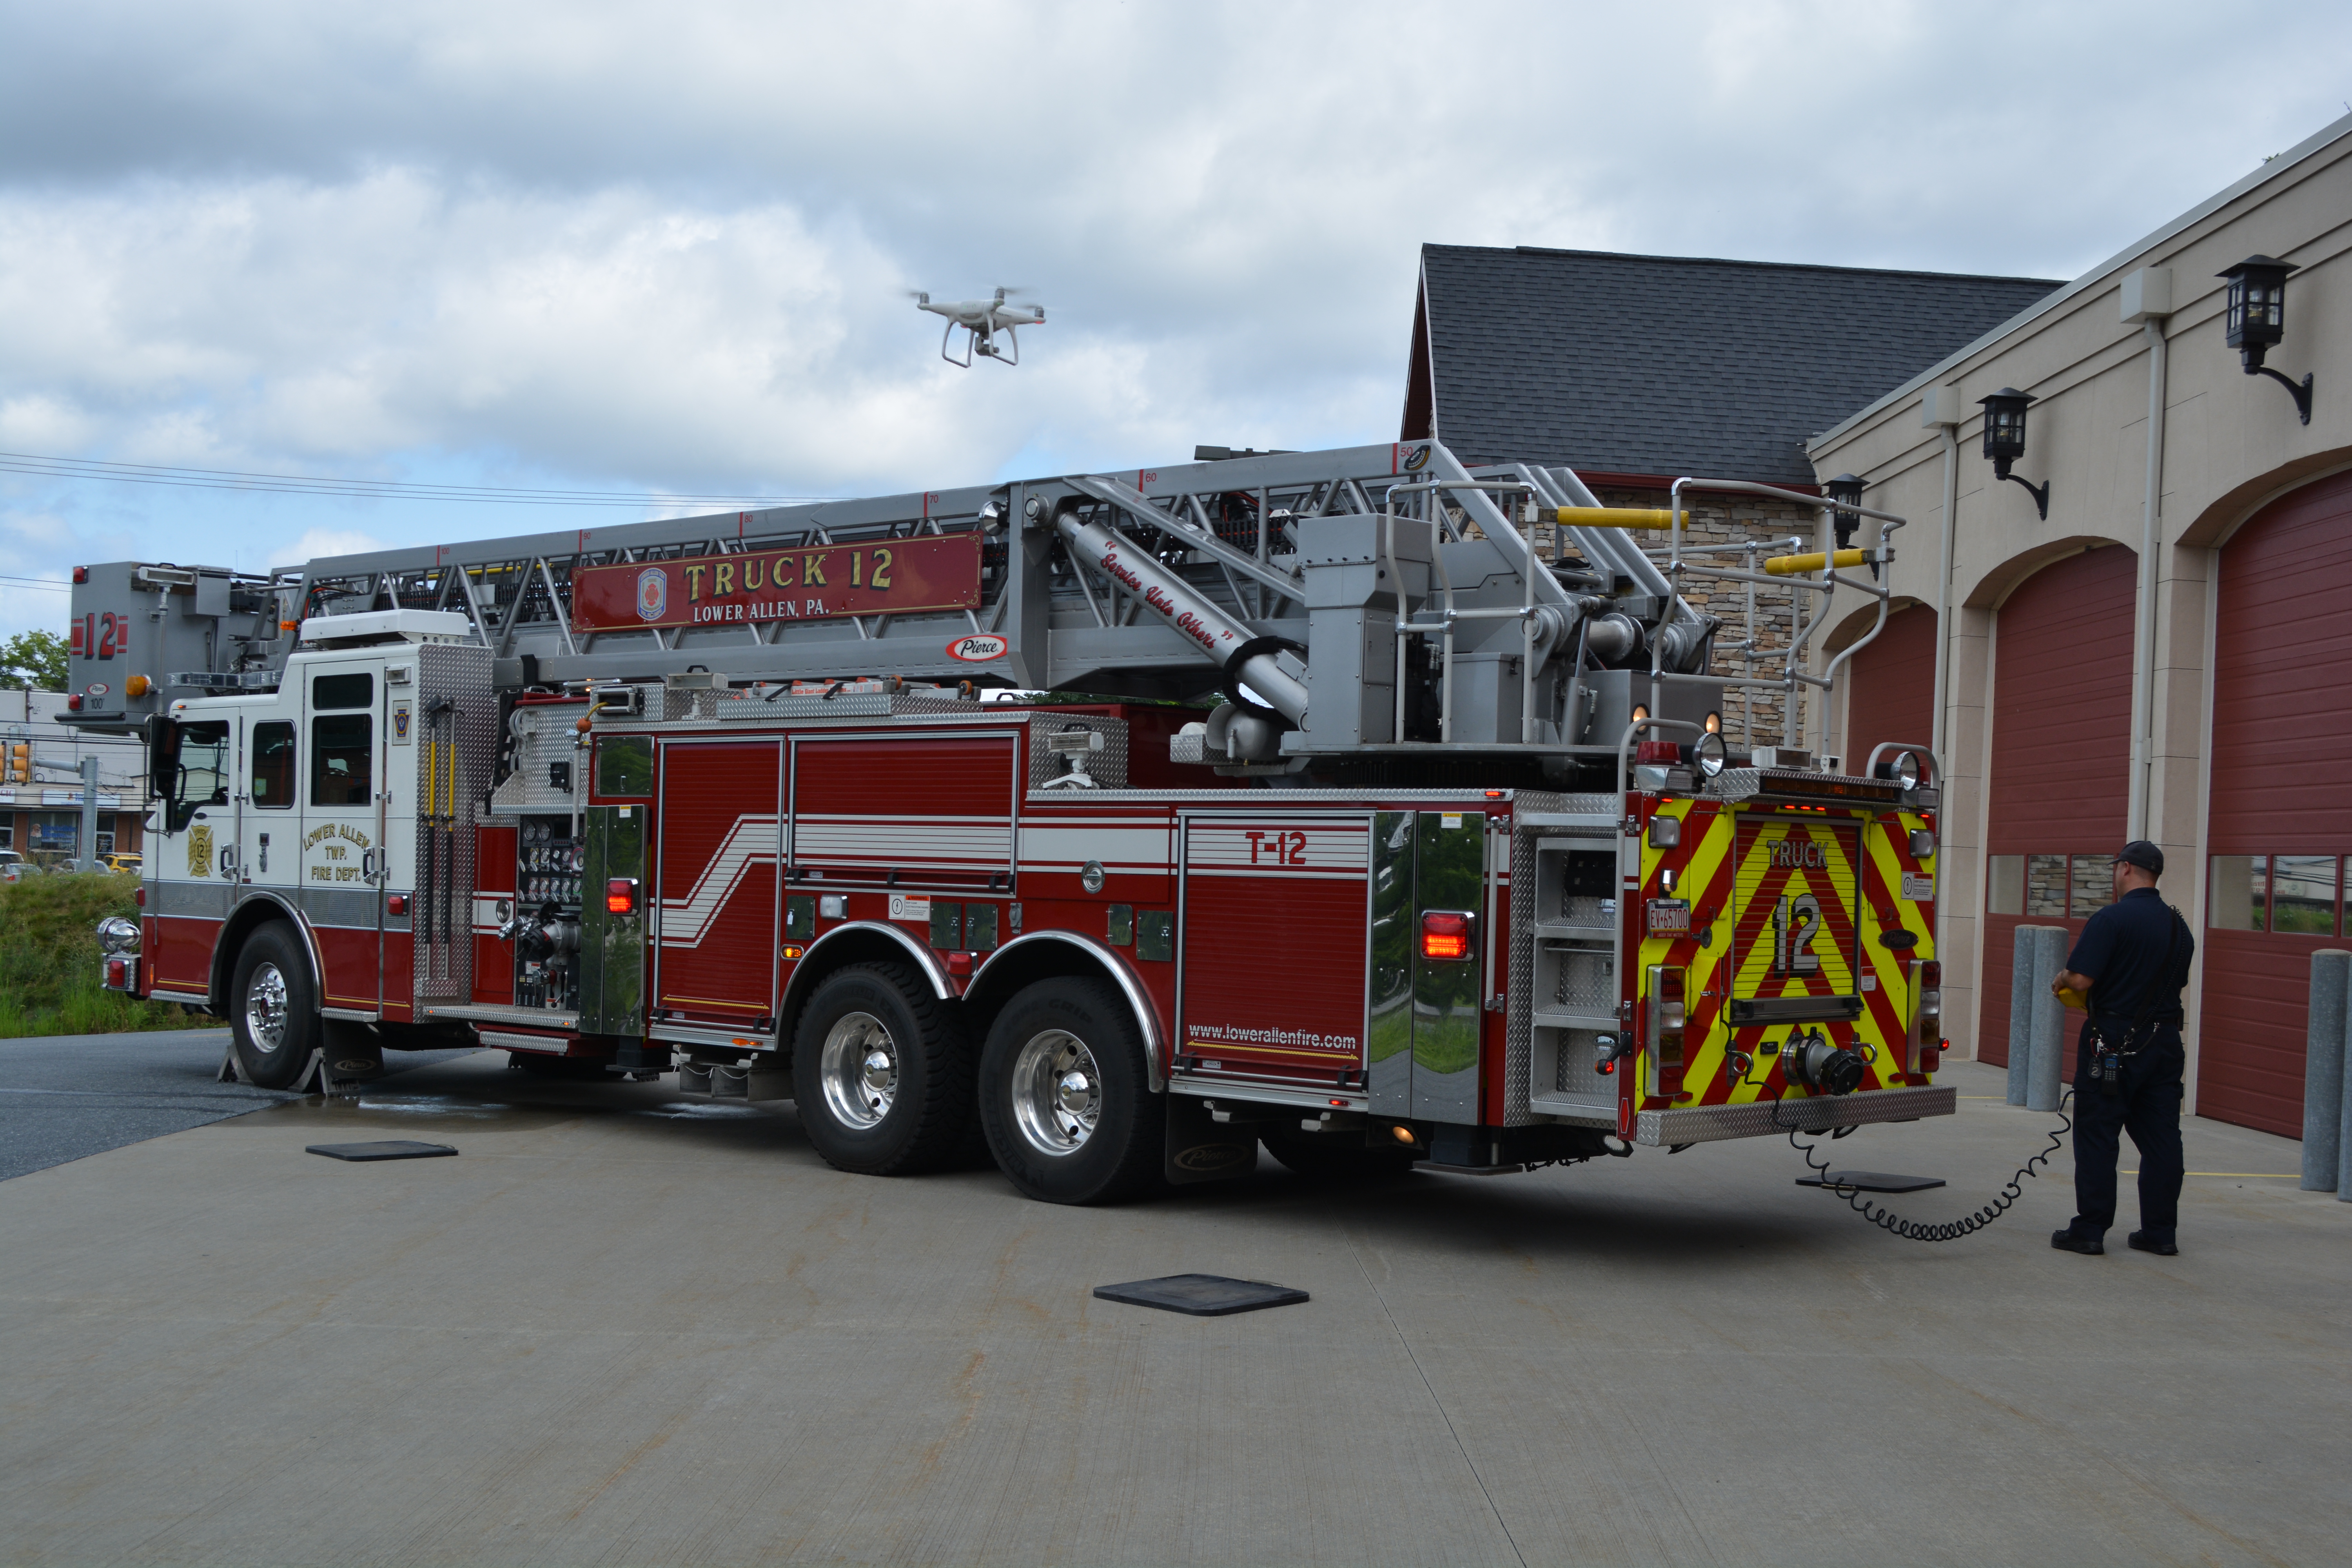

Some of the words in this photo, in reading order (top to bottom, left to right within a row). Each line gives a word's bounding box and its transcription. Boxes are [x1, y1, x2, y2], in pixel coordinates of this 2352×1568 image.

[1400, 446, 1413, 457] 50
[1145, 472, 1157, 483] 60
[929, 494, 939, 504] 70
[745, 514, 753, 523] 80
[684, 553, 828, 605] TRUCK
[850, 548, 893, 591] 12
[1145, 586, 1174, 616] Unto
[693, 604, 743, 622] LOWER
[749, 600, 799, 618] ALLEN,
[806, 599, 829, 615] PA.
[84, 612, 117, 660] 12
[960, 639, 998, 657] Pierce
[303, 823, 336, 851] LOWER
[338, 824, 370, 849] ALLEN
[197, 844, 204, 858] 12
[325, 846, 348, 860] TWP.
[1245, 831, 1307, 865] T-12
[1766, 840, 1829, 869] TRUCK
[312, 866, 332, 880] FIRE
[336, 866, 361, 882] DEPT.
[1772, 893, 1821, 978] 12
[1189, 1024, 1356, 1049] www.lowerallenfire.com
[2091, 1067, 2098, 1076] 2
[1187, 1149, 1236, 1165] Pierce
